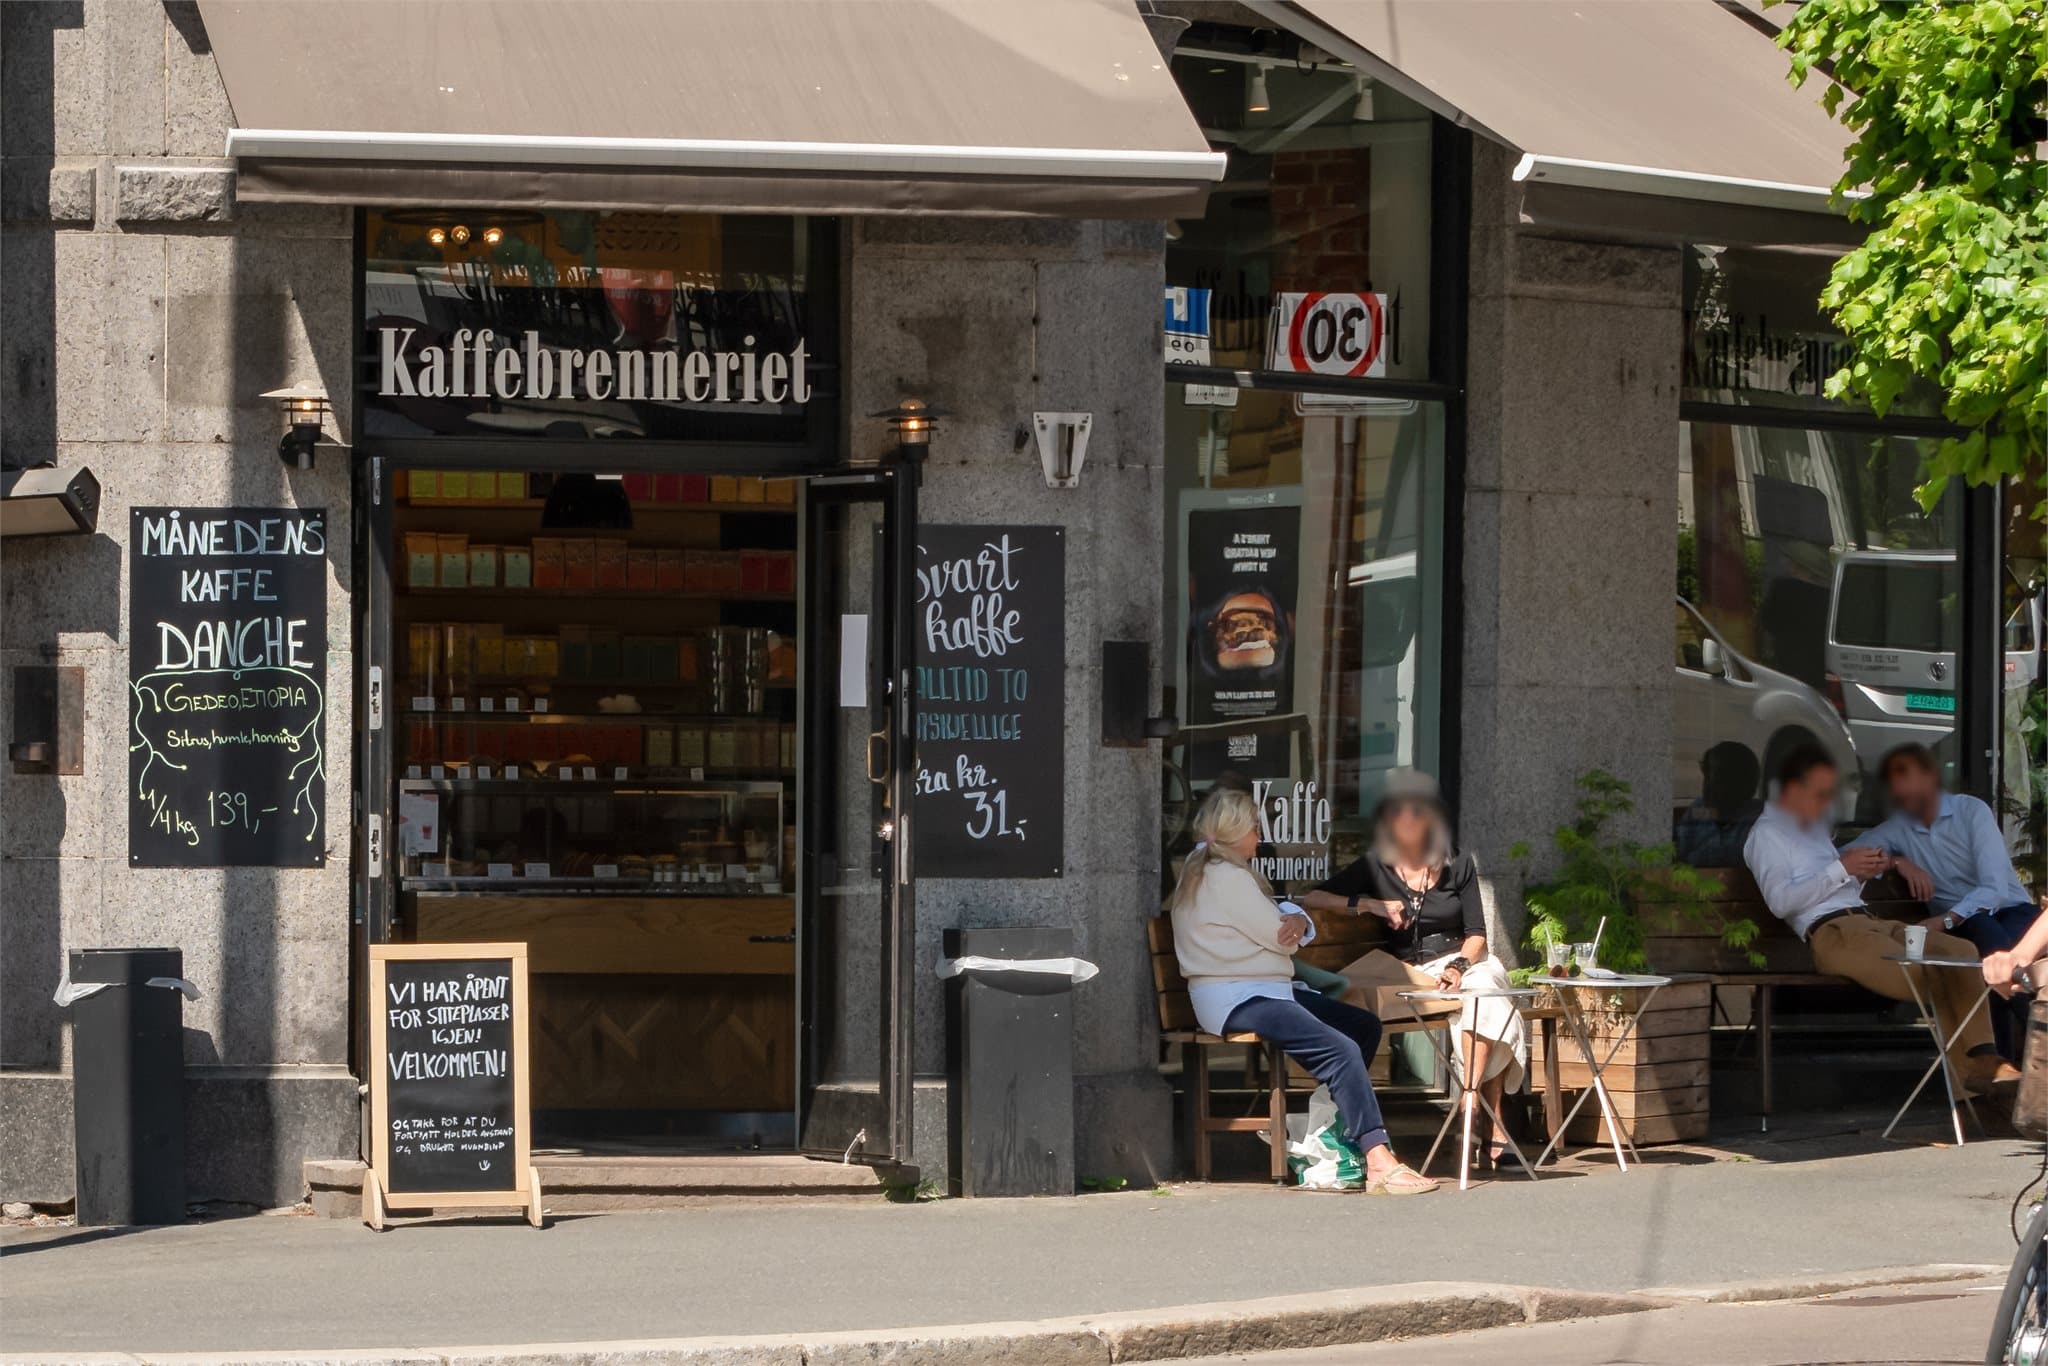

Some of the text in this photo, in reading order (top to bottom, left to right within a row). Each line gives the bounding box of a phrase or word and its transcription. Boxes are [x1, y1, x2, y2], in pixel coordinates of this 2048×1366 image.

[378, 327, 812, 404] Kaffebrenneriet
[142, 510, 325, 556] MÅNEDENS
[181, 568, 278, 602] KAFFE
[925, 592, 1025, 658] kaffe
[155, 616, 315, 670] DANCHE
[995, 668, 1029, 703] TO
[915, 758, 951, 796] ra
[175, 810, 200, 846] kg
[1251, 780, 1332, 845] Kaffe
[389, 973, 510, 1005] VI HAR ÅPENT
[389, 1008, 422, 1030] FOR
[432, 1028, 482, 1045] IGJEN!
[388, 1049, 507, 1081] VELKOMMEN!
[392, 1118, 410, 1130] OG
[441, 1117, 459, 1127] FOR
[463, 1116, 478, 1127] AT
[481, 1117, 497, 1128] DU
